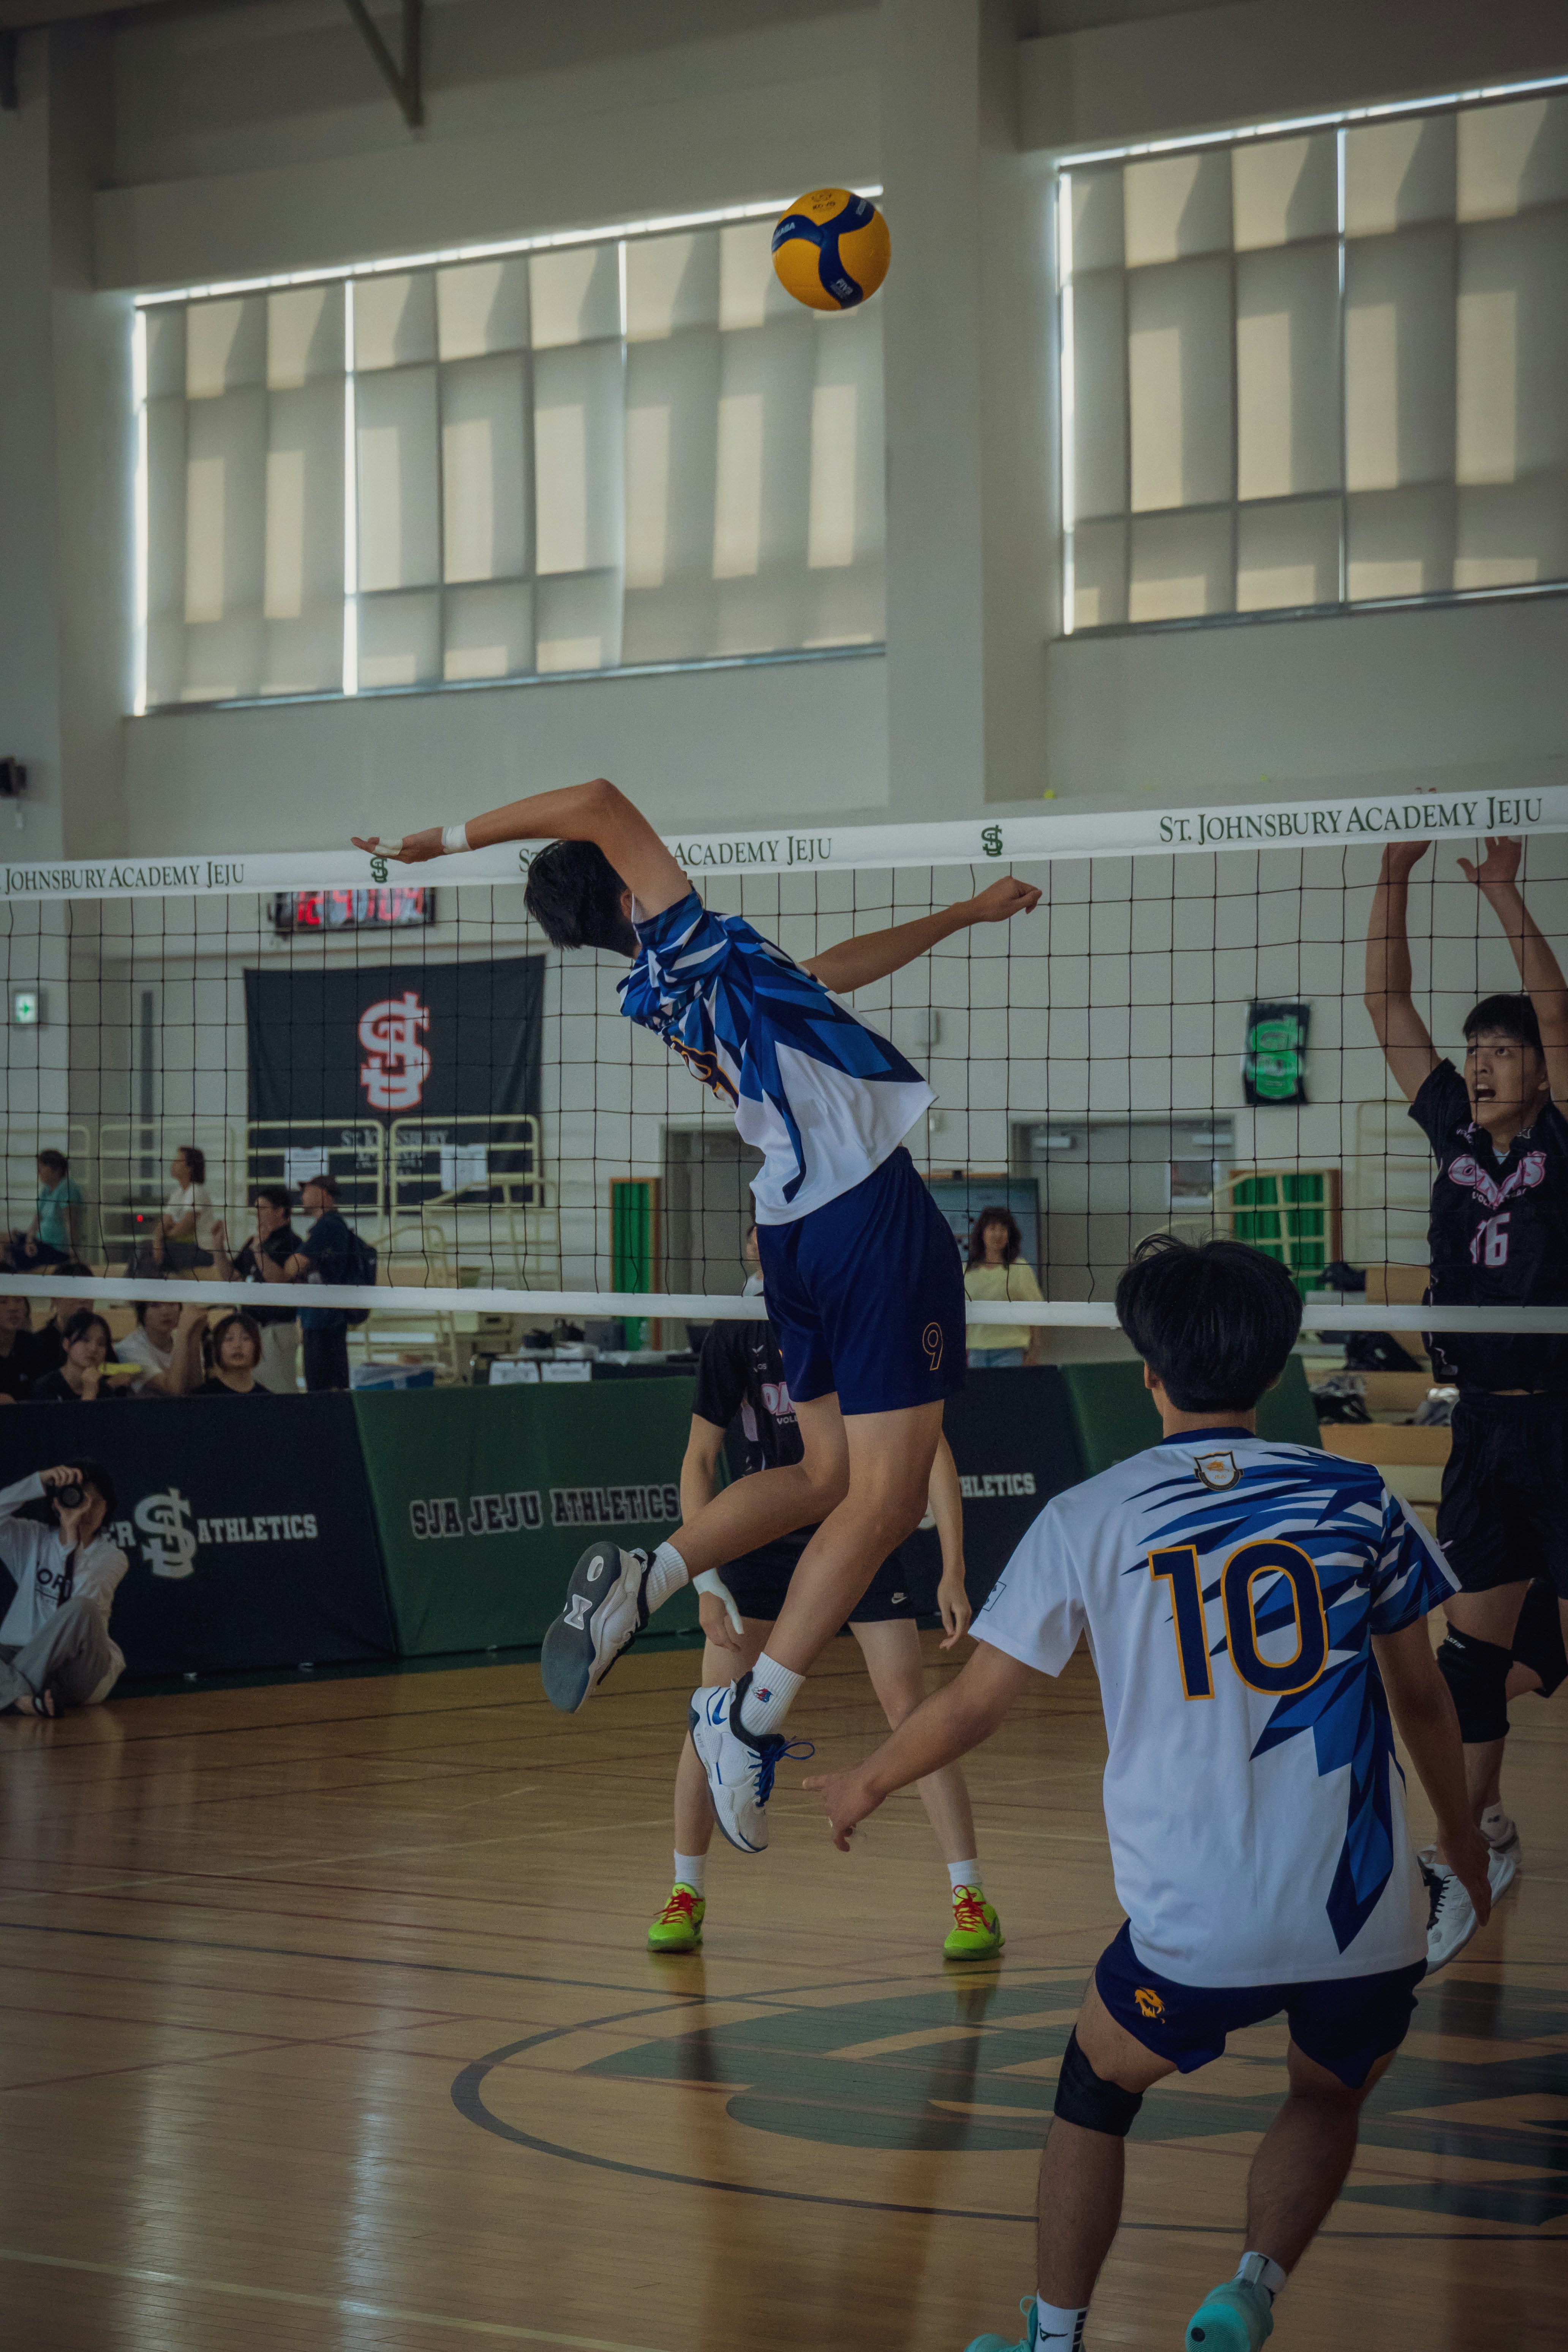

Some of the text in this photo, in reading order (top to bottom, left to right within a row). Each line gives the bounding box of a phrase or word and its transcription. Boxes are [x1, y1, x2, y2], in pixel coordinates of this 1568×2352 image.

[1198, 810, 1342, 846] JOHNSBURY
[1346, 801, 1478, 833] ACADEMY
[1486, 796, 1542, 830] JEJU
[675, 840, 779, 866] ACADEMY
[787, 836, 832, 866] JEJU
[5, 861, 244, 895] JOHNSBURY ACADEMY JEJU
[1469, 1212, 1511, 1268] 16
[922, 1322, 943, 1371] 9
[959, 1472, 1036, 1498] HLETICS
[197, 1514, 318, 1544] ATHLETICS
[409, 1483, 681, 1540] SJA JEJU ATHLETICS
[1148, 1539, 1329, 1701] 10
